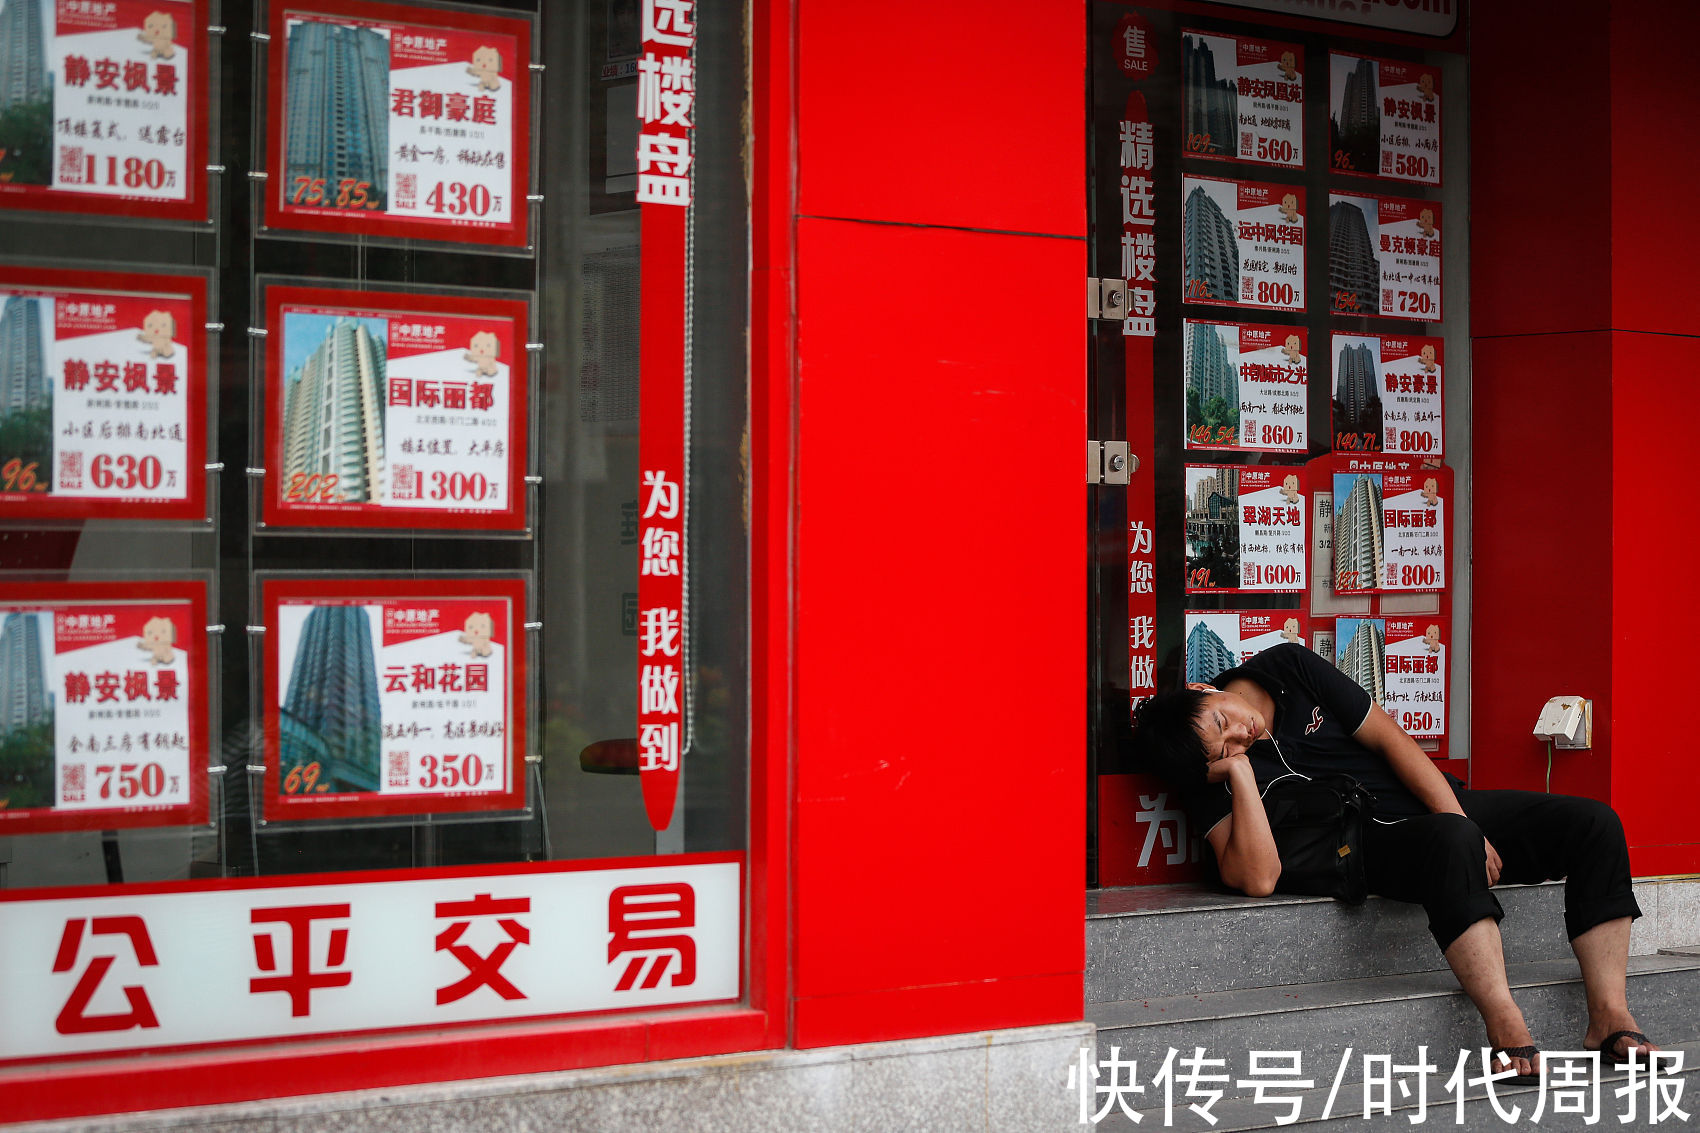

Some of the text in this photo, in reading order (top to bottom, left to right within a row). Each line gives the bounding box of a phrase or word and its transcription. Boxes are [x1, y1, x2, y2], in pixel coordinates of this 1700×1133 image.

[1123, 25, 1147, 58] 售
[64, 54, 179, 95] 静安枫景
[1124, 59, 1148, 71] SALE
[1237, 77, 1302, 103] 静安凤凰苑
[390, 88, 497, 125] 君御豪庭
[1383, 97, 1436, 123] 静安枫景
[1119, 120, 1157, 337] 精选楼盘
[1238, 221, 1303, 246] 远中风华园
[1380, 234, 1440, 258] 曼克顿豪庭
[1258, 281, 1300, 305] 800万
[63, 358, 179, 395] 静安枫景
[1240, 362, 1308, 385] 中凯城市之光
[1385, 373, 1438, 395] 静安豪景
[389, 377, 495, 411] 国际丽都
[1262, 425, 1303, 445] 860万
[1400, 430, 1439, 452] 800万
[1243, 505, 1301, 527] 翠湖天地
[1384, 509, 1437, 528] 国际丽都
[1255, 564, 1301, 585] 1600万
[1401, 564, 1441, 586] 800万
[639, 470, 680, 772] 为您 我做到
[1129, 521, 1155, 728] 为您 我做
[1386, 654, 1439, 674] 国际丽都
[64, 669, 180, 704] 静安枫景
[383, 663, 488, 693] 云和花园
[1403, 711, 1441, 731] 950万
[1135, 793, 1200, 866] 为
[52, 882, 696, 1036] 公平交易
